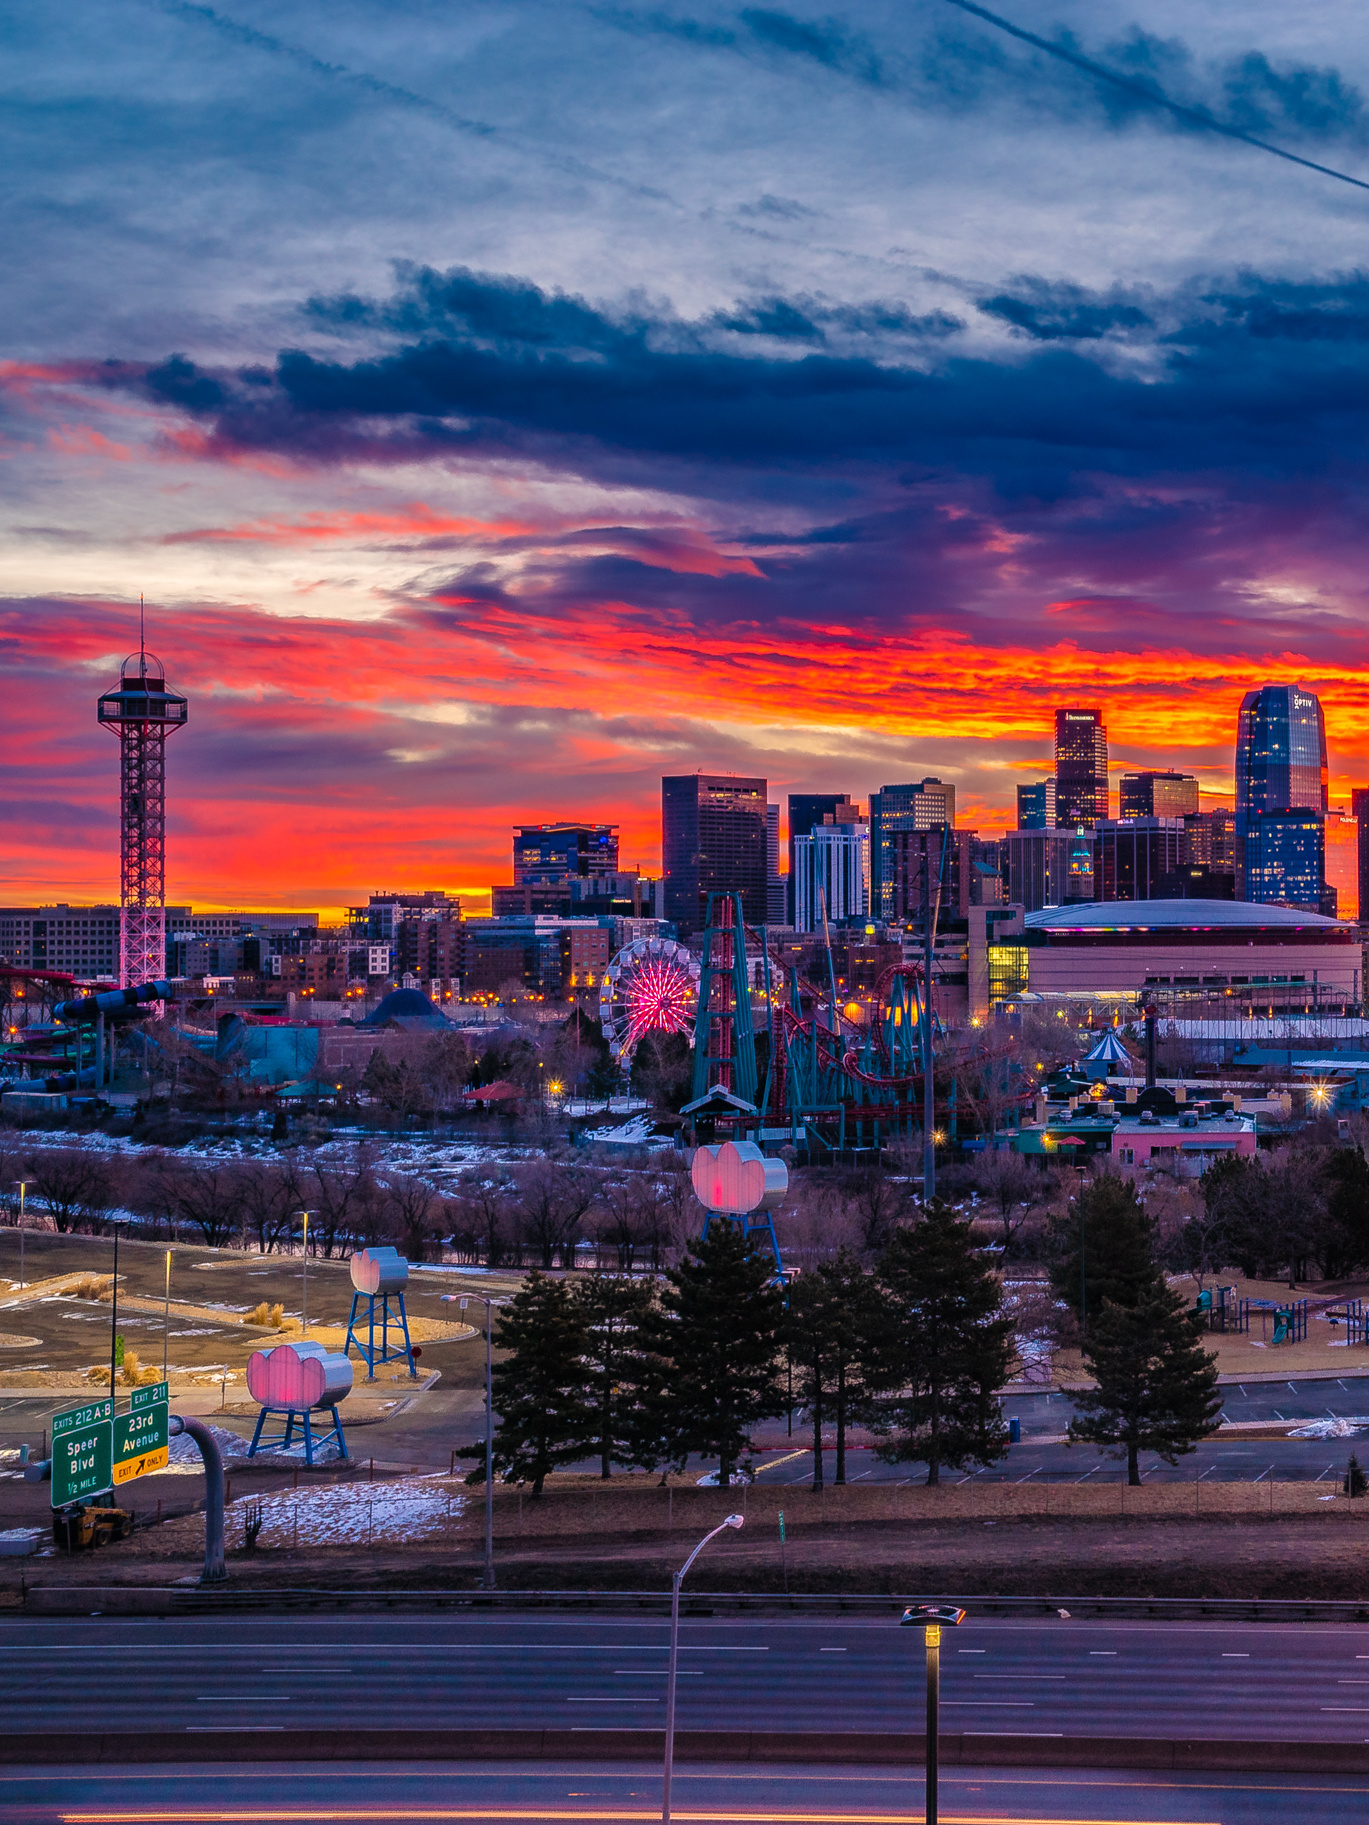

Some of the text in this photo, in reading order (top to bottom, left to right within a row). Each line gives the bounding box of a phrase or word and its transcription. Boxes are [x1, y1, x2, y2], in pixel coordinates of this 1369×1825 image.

[1294, 696, 1312, 708] OPTIV
[135, 1386, 165, 1404] EXIT 211
[54, 1417, 73, 1430] EXITS
[75, 1409, 92, 1425] 212
[128, 1412, 153, 1433] 23rd
[67, 1437, 98, 1457] Speer
[122, 1431, 159, 1453] Avenue
[71, 1454, 95, 1474] Blvd
[118, 1456, 163, 1478] EXIT ONLY
[80, 1476, 97, 1489] MILE
